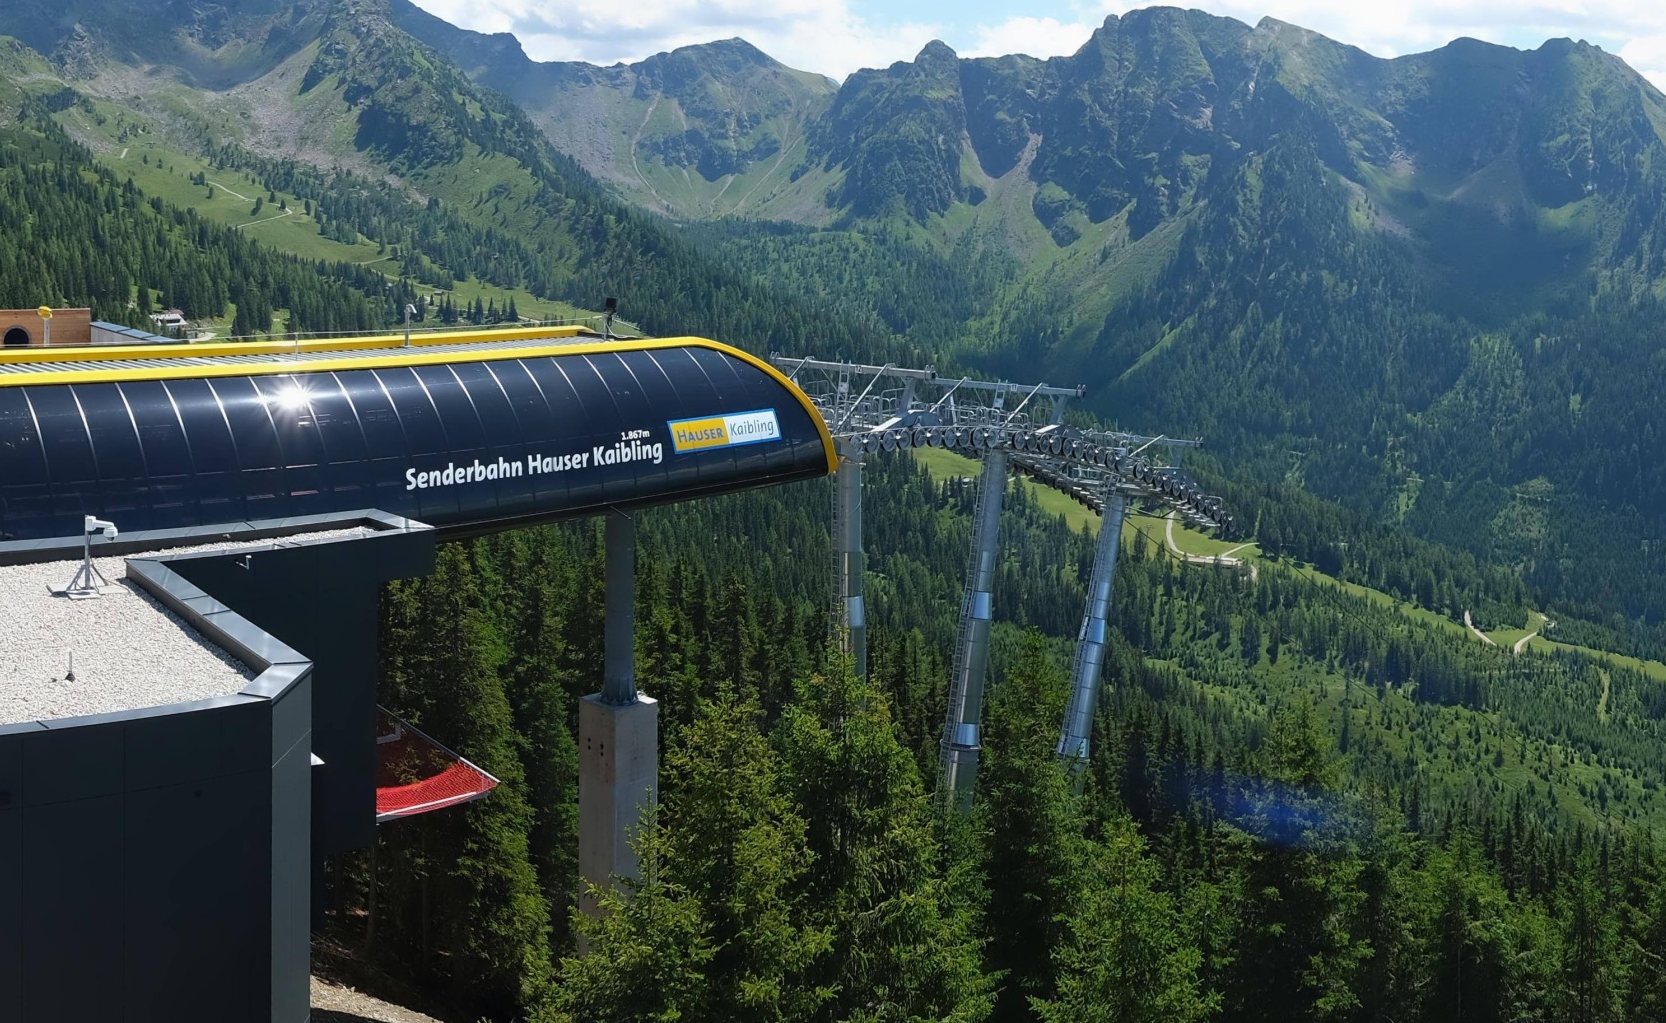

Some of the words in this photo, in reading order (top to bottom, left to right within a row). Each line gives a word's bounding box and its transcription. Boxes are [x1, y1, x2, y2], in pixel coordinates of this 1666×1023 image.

[677, 426, 724, 443] HAUSER
[730, 418, 774, 436] Kaibling
[405, 456, 523, 490] Senderbahn
[528, 450, 589, 475] Hauser
[593, 440, 663, 465] Kaibling
